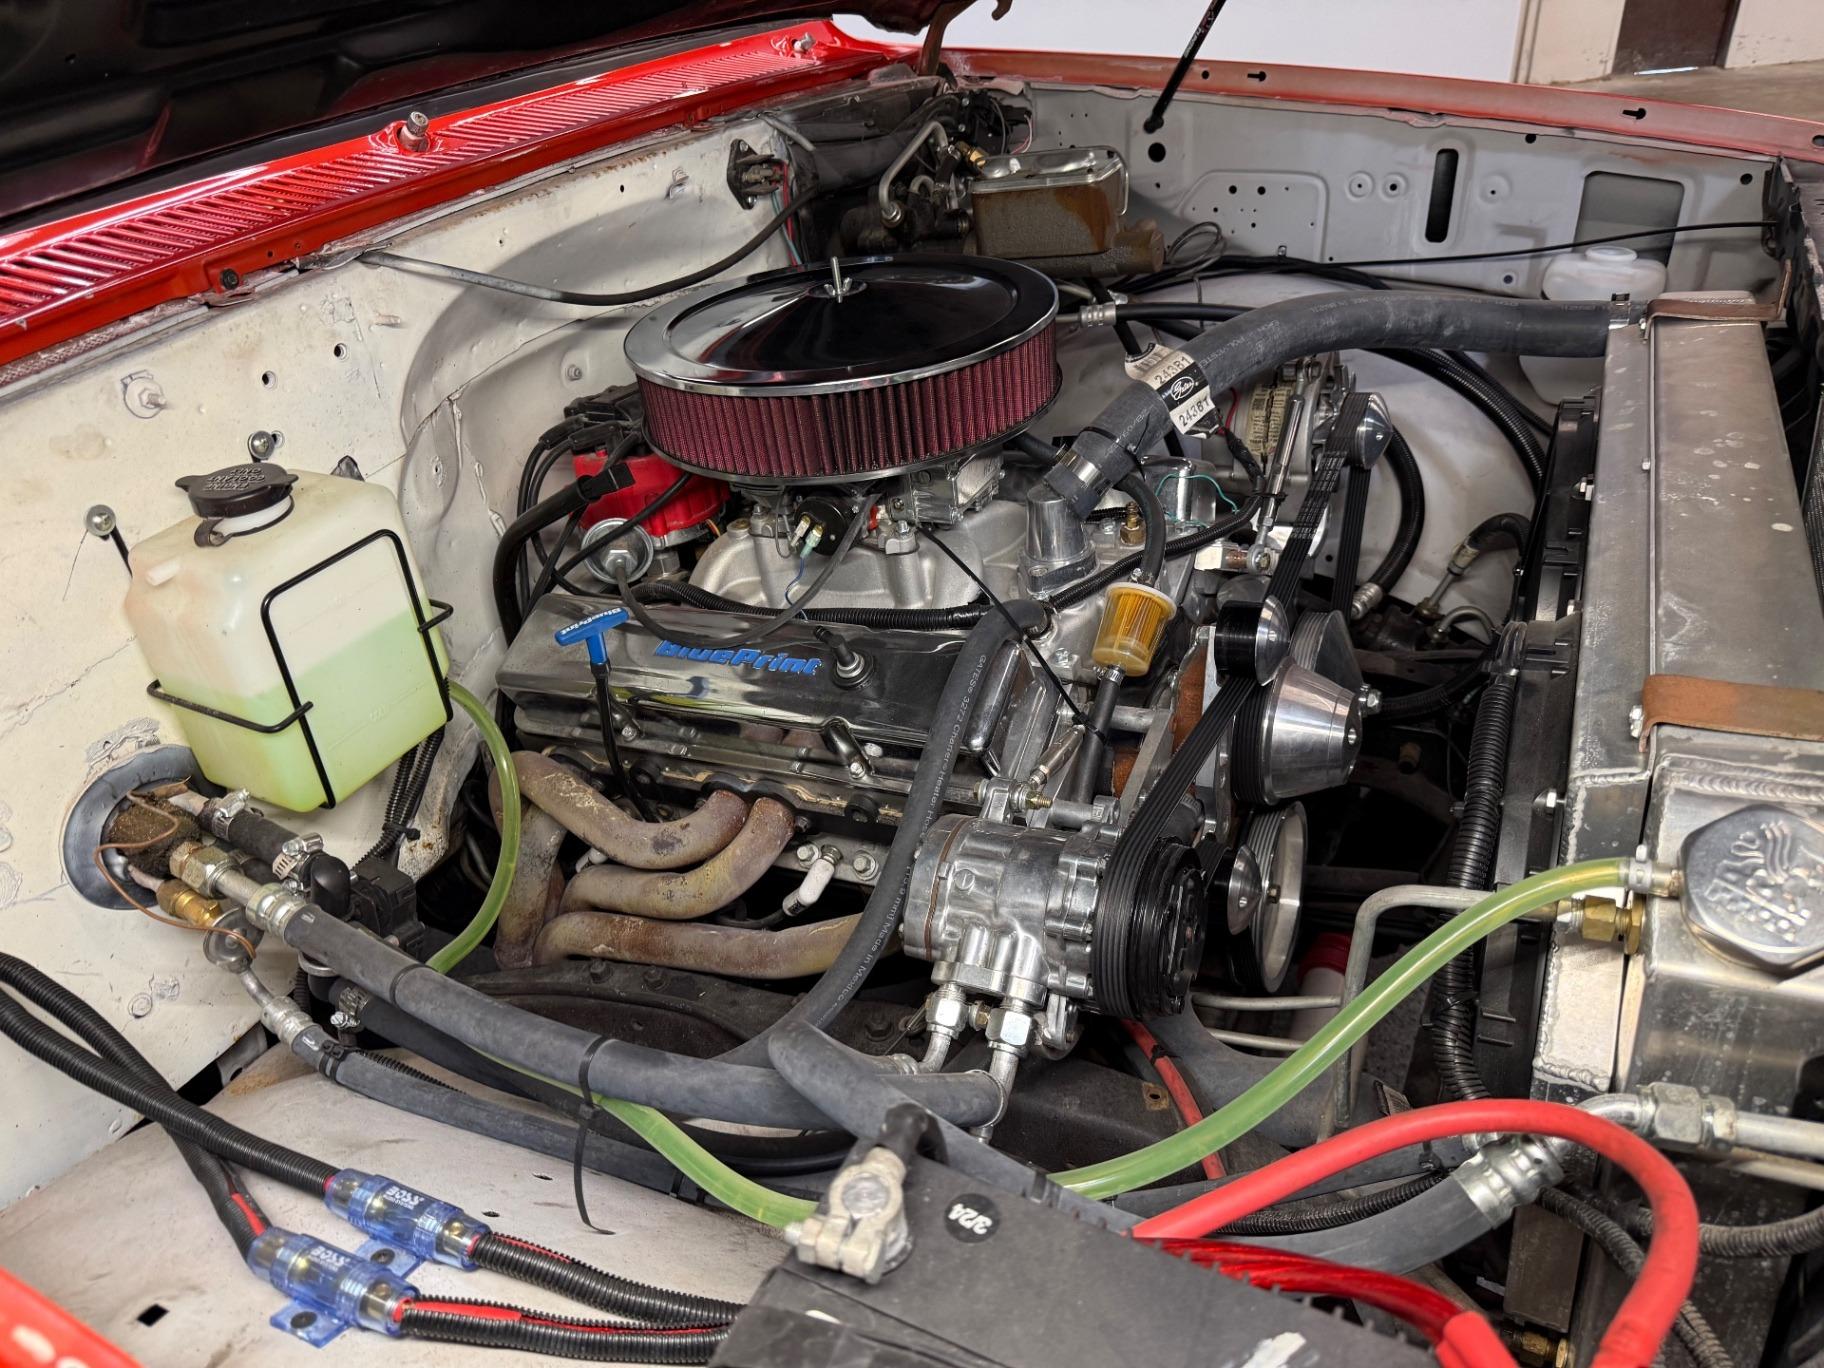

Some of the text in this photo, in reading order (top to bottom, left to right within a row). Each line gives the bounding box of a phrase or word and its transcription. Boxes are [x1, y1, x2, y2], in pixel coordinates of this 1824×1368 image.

[872, 921, 891, 952] Made
[838, 966, 867, 1001] Mexico
[948, 1203, 993, 1235] 3/24
